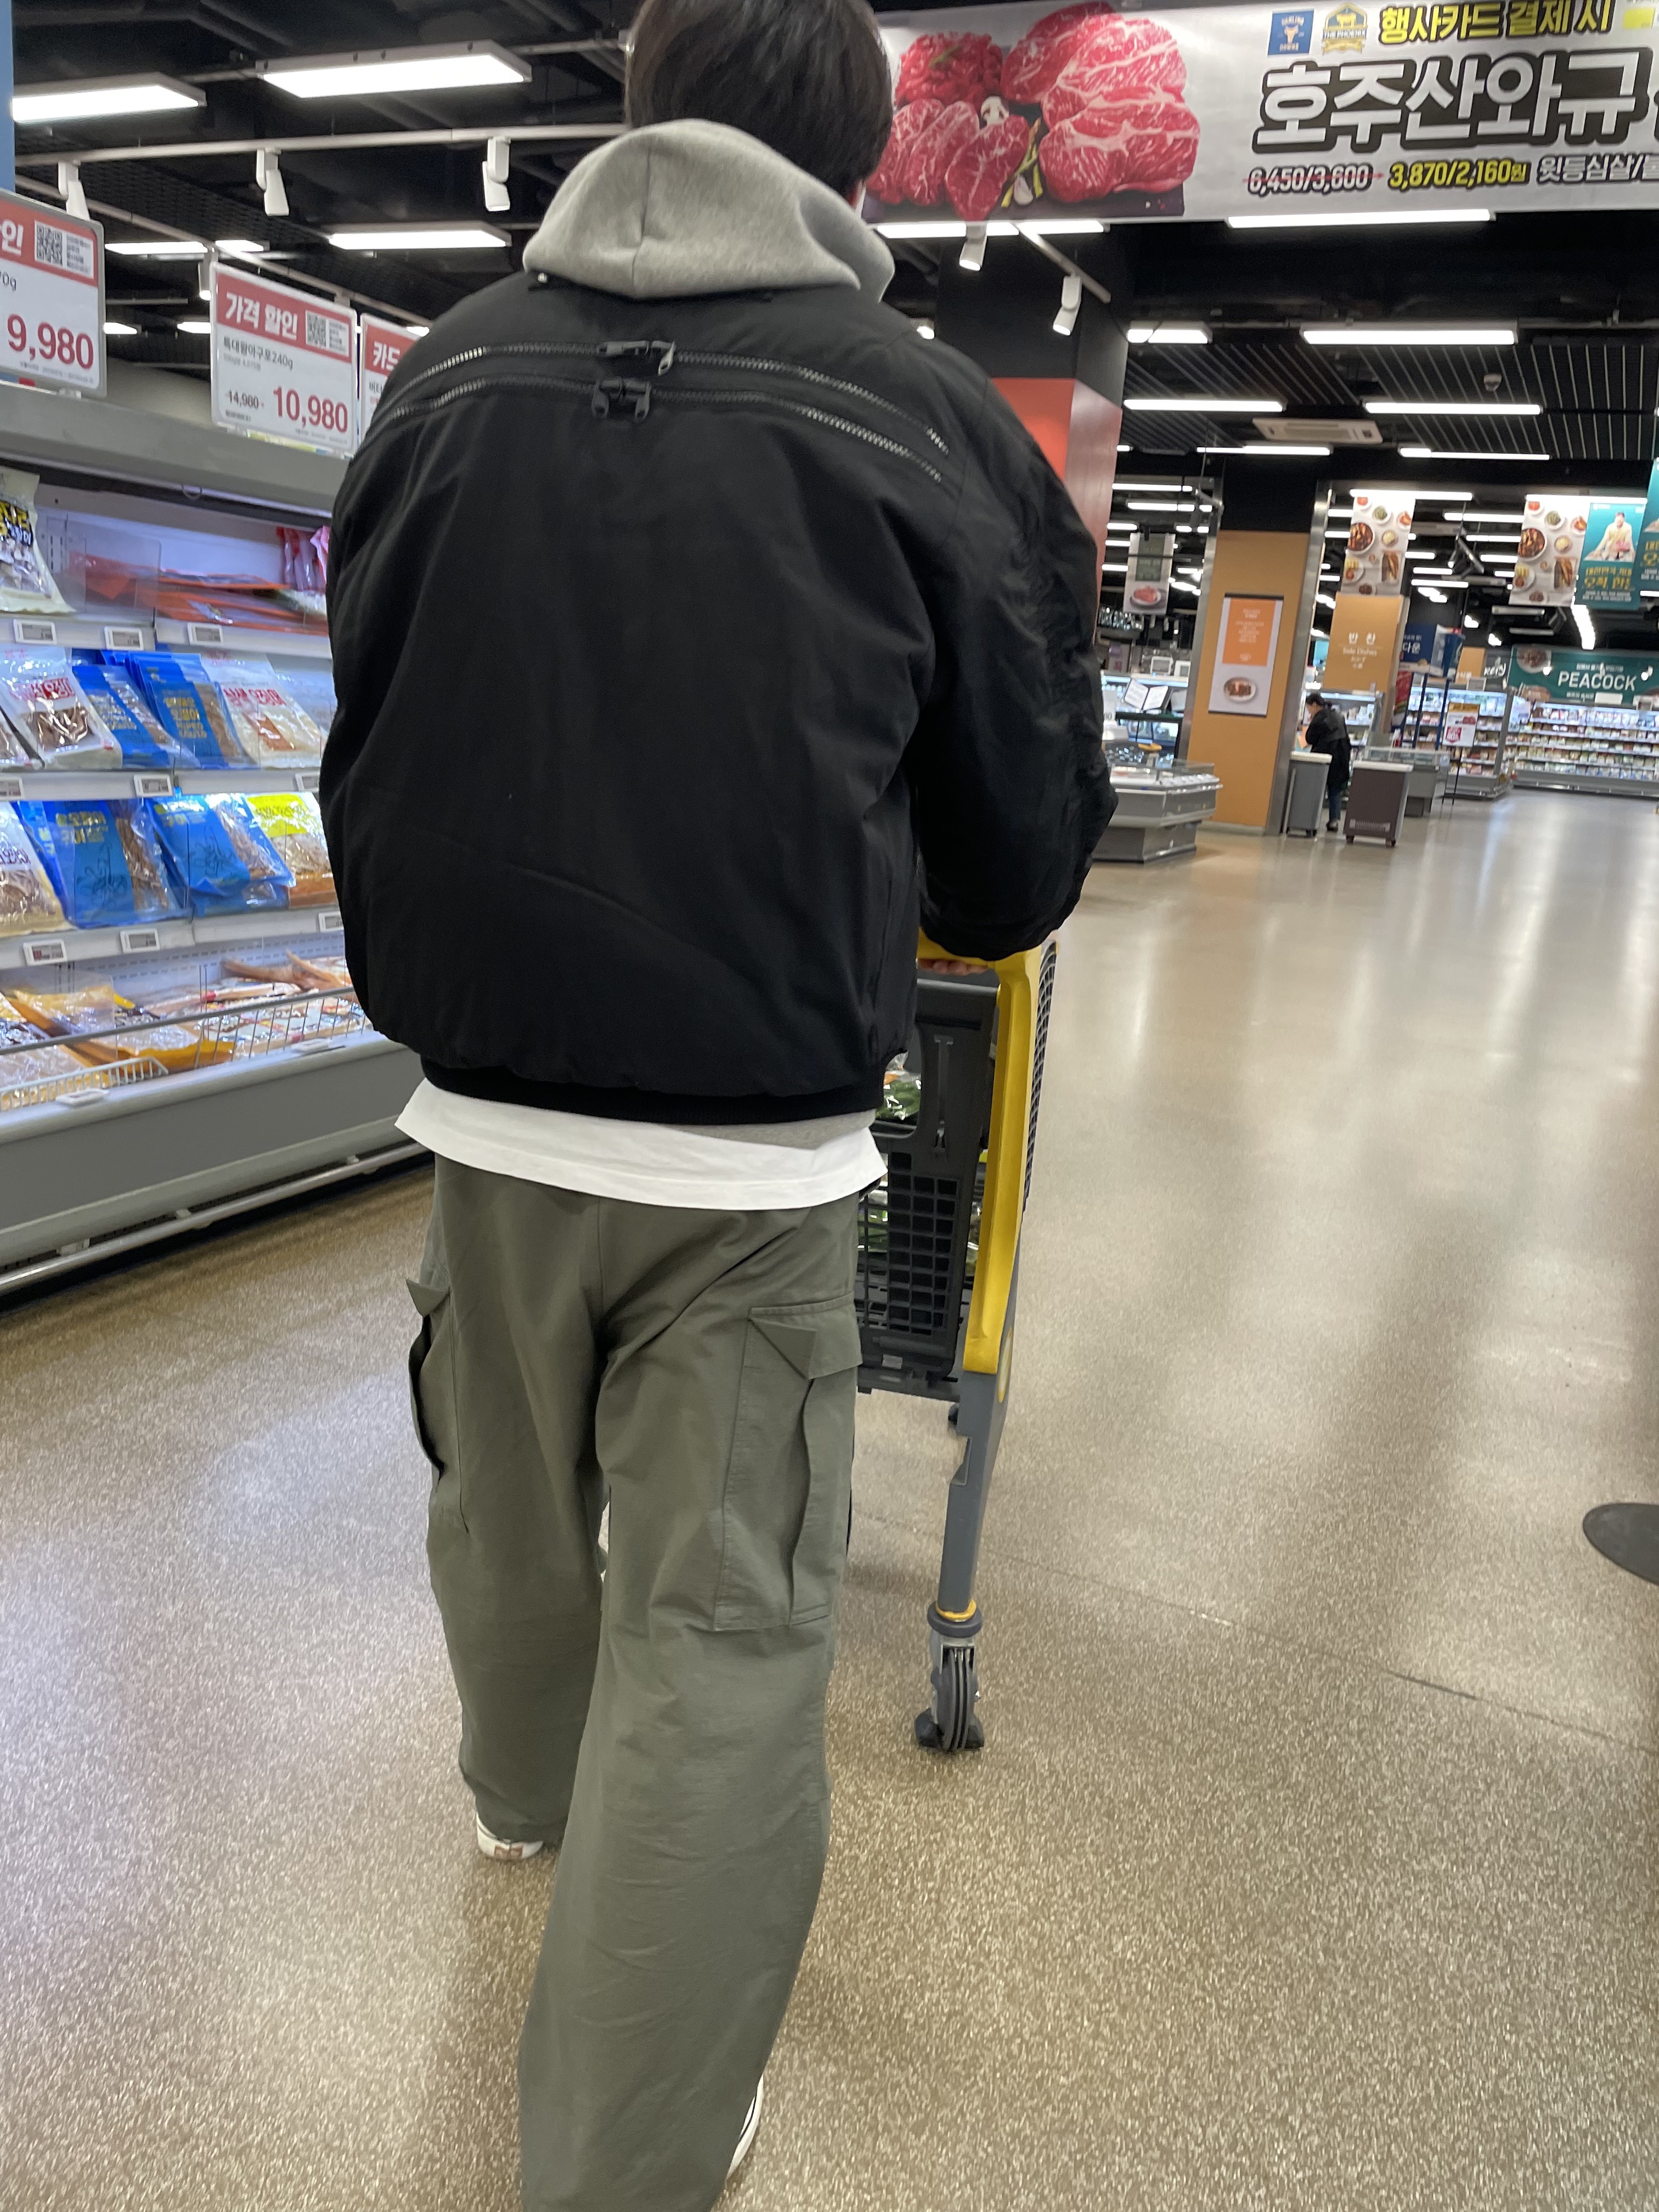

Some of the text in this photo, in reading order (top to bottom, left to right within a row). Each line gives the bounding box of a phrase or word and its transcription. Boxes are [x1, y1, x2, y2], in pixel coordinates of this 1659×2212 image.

[1380, 2, 1502, 44] 행사카드
[1509, 0, 1572, 35] 결제
[1255, 50, 1641, 147] 호주산와규
[1249, 164, 1370, 194] 6,450/3,600
[0, 220, 24, 256] 인
[225, 291, 261, 329] 가격
[264, 303, 298, 341] 할인
[7, 313, 94, 369] 9,980
[373, 340, 400, 371] 카드
[273, 385, 348, 433] 10,980
[1558, 670, 1638, 692] PEACOCK
